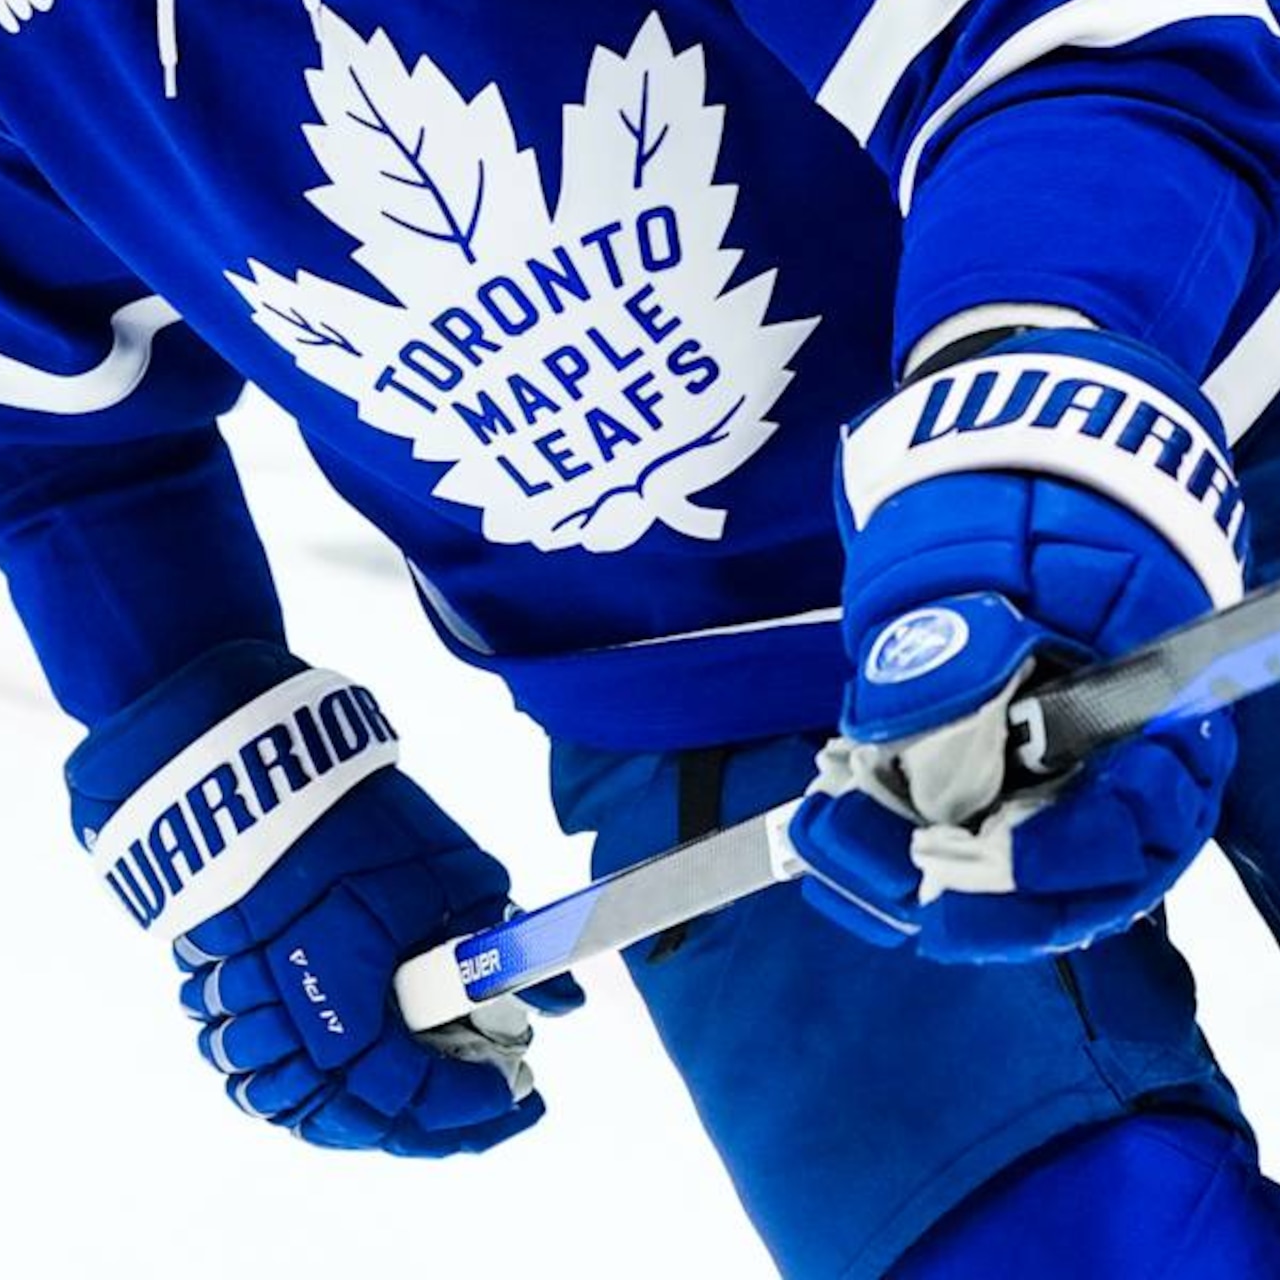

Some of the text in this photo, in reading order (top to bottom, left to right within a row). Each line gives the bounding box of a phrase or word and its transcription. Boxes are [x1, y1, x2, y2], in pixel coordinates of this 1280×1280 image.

[373, 205, 682, 414] TORONTO
[450, 283, 682, 447] MAPLE
[495, 338, 721, 498] LEAFS
[105, 684, 400, 930] WARRIOR
[458, 947, 502, 985] AUER
